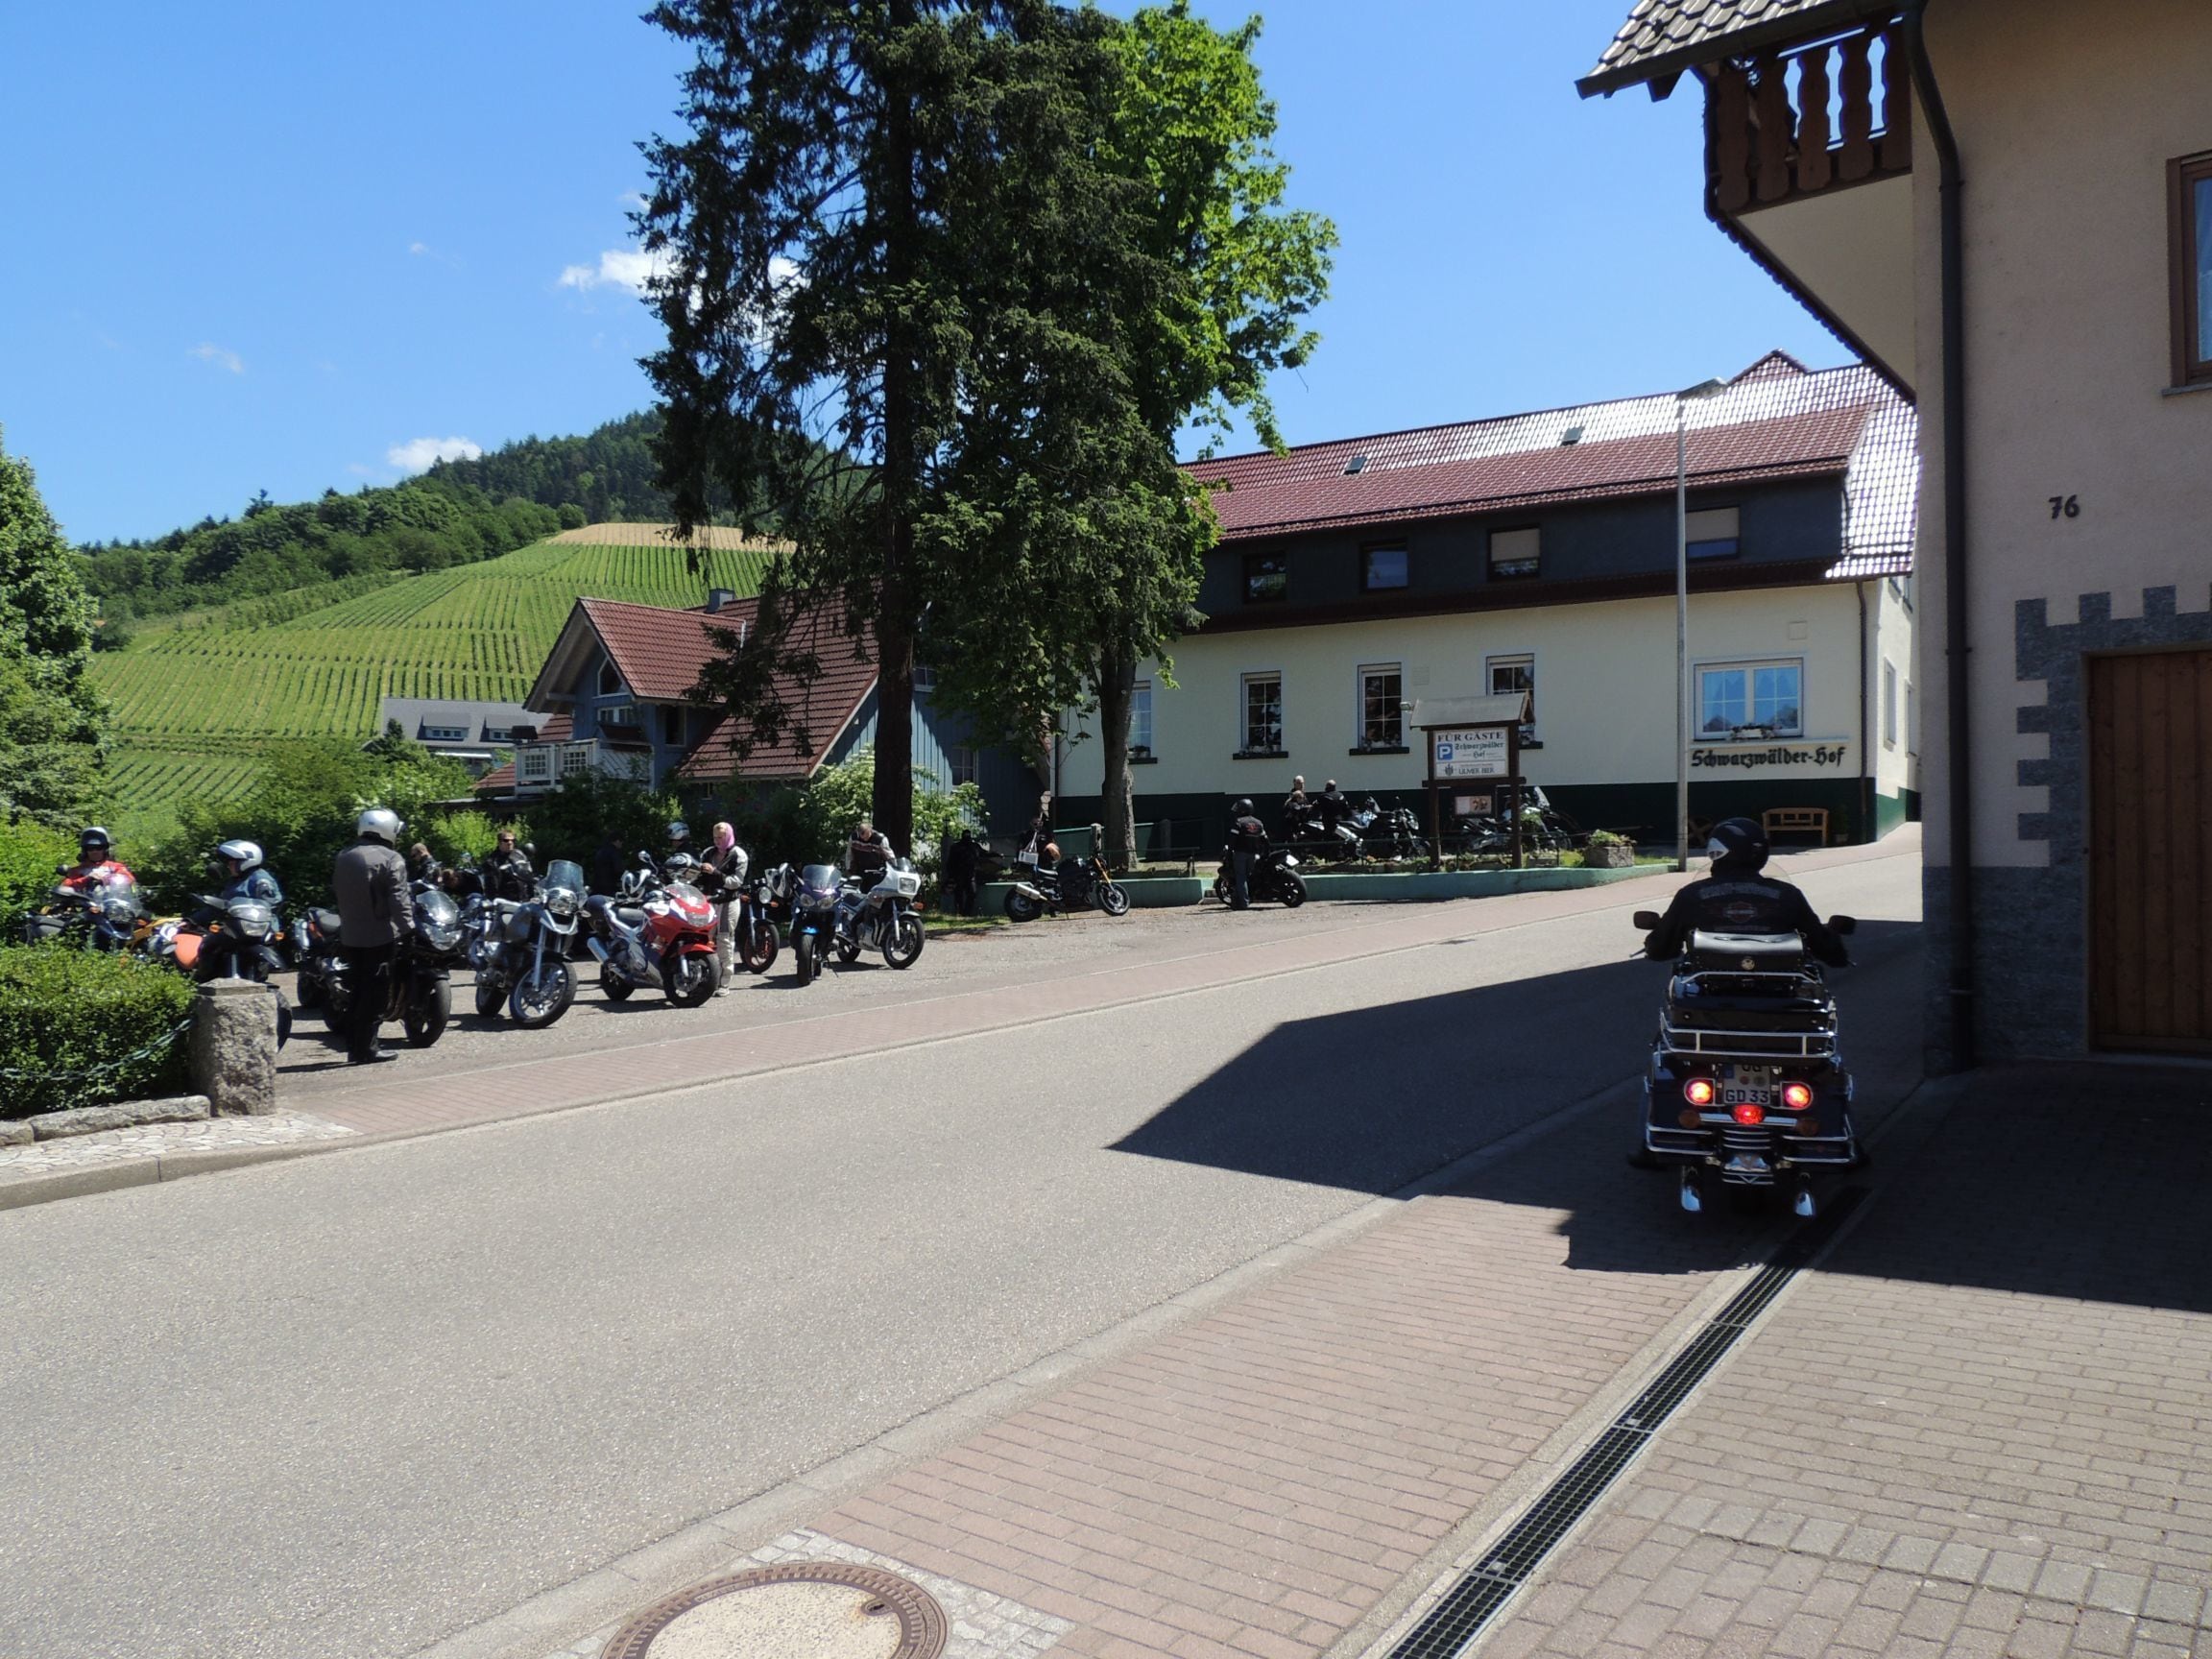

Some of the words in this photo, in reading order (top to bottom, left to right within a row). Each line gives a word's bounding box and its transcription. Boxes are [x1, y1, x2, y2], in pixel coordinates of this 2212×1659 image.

[2049, 494, 2080, 519] 76
[1438, 732, 1461, 742] FÜR
[1464, 731, 1503, 741] GÄSTE
[1439, 746, 1452, 758] P
[1692, 746, 1845, 768] Schwarzwälder-Hof
[1726, 1090, 1745, 1102] GD
[1750, 1090, 1768, 1103] 33
